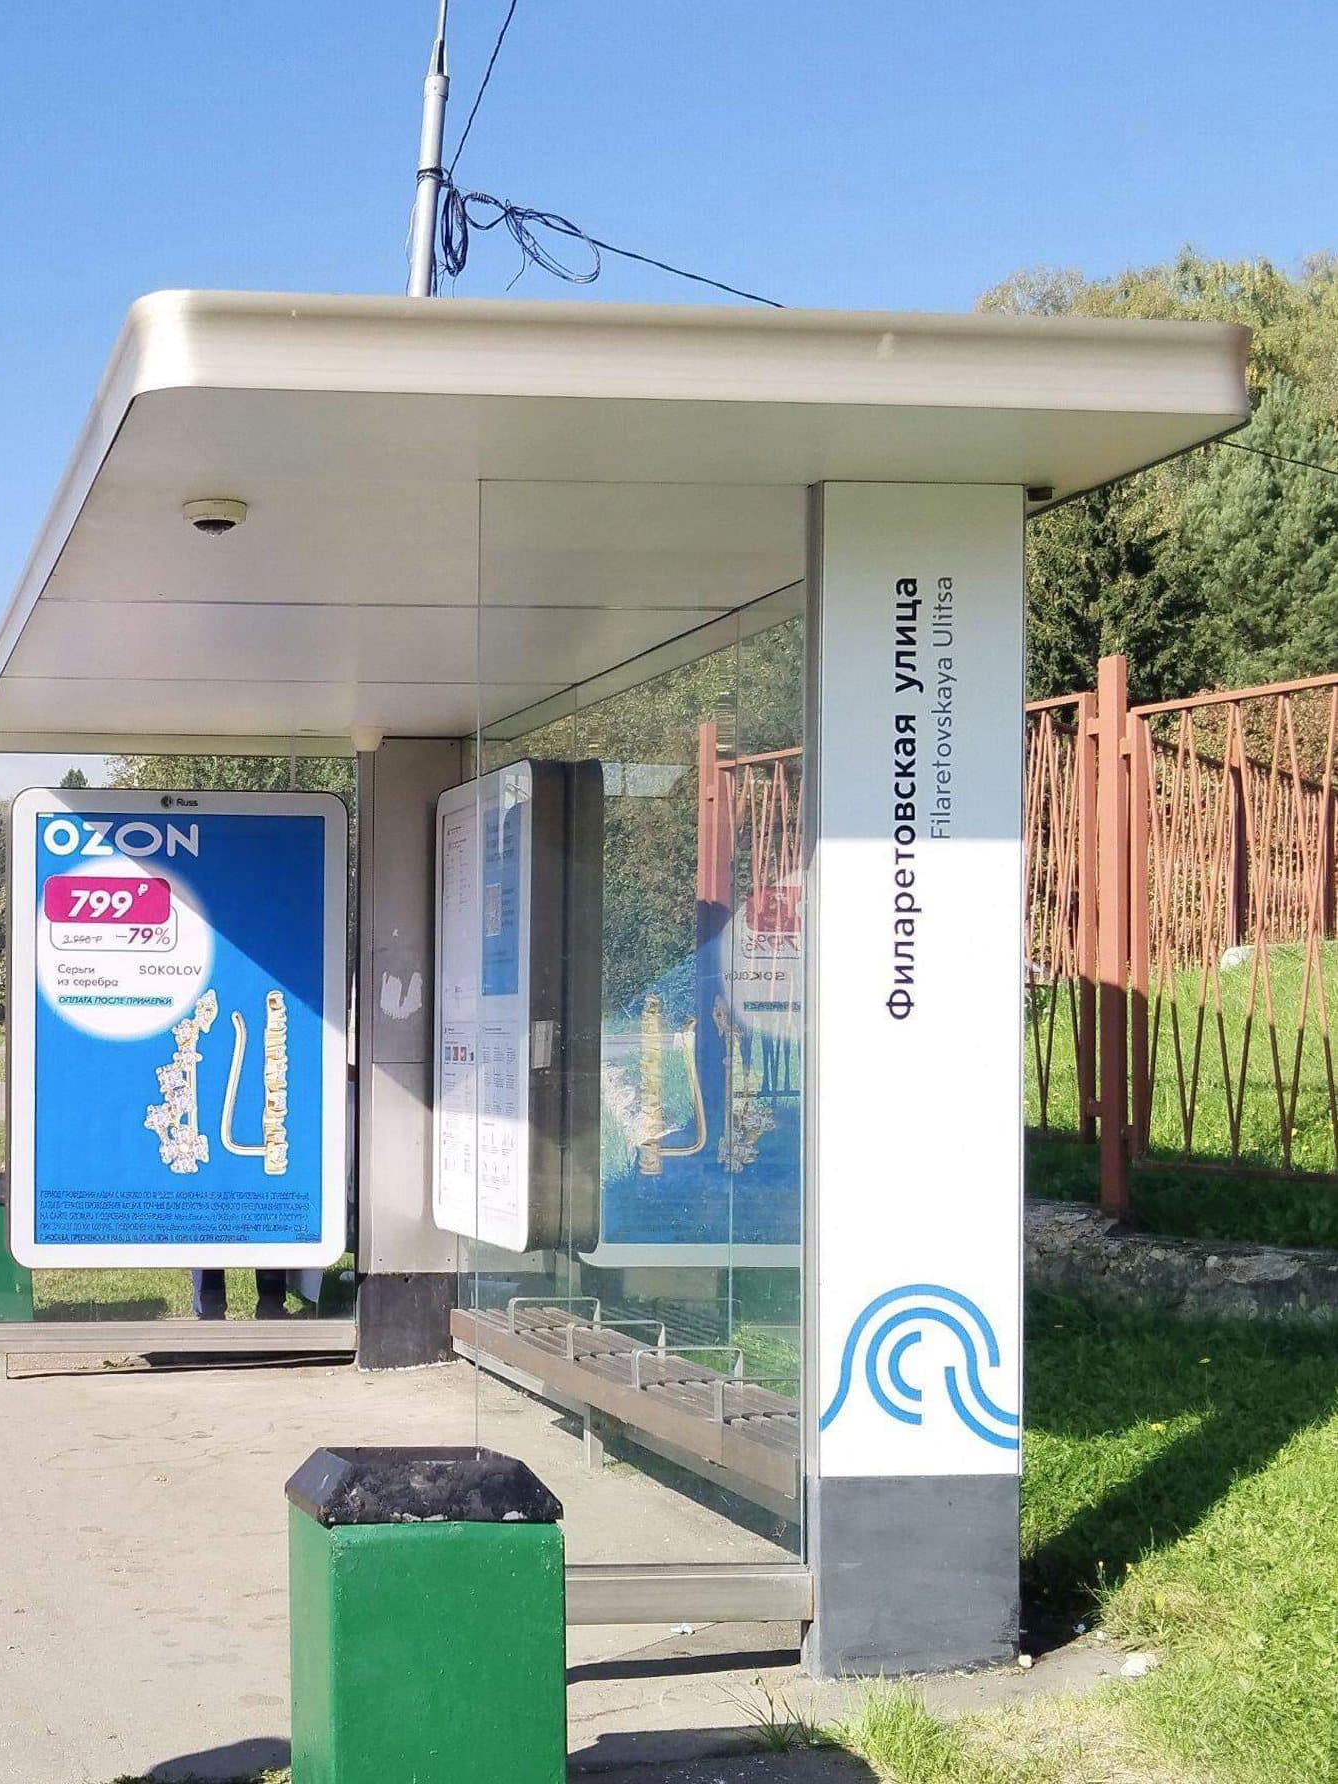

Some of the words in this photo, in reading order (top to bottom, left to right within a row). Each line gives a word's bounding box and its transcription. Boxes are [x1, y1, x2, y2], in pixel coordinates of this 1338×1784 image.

[932, 577, 953, 647] Ulitsa
[895, 578, 924, 694] улица
[931, 657, 958, 840] Filaretovskaya
[176, 798, 199, 807] Russ
[43, 819, 199, 858] OZON
[886, 714, 922, 1020] Филаретовская
[68, 890, 134, 919] 799
[57, 964, 95, 975] Серьги
[57, 979, 69, 987] из
[73, 977, 119, 988] серебра
[139, 965, 203, 976] SOKOLOV
[58, 996, 93, 1005] ОПЛАТА
[95, 996, 125, 1005] ПОСЛЕ
[127, 996, 173, 1006] ПРИМЕРКИ
